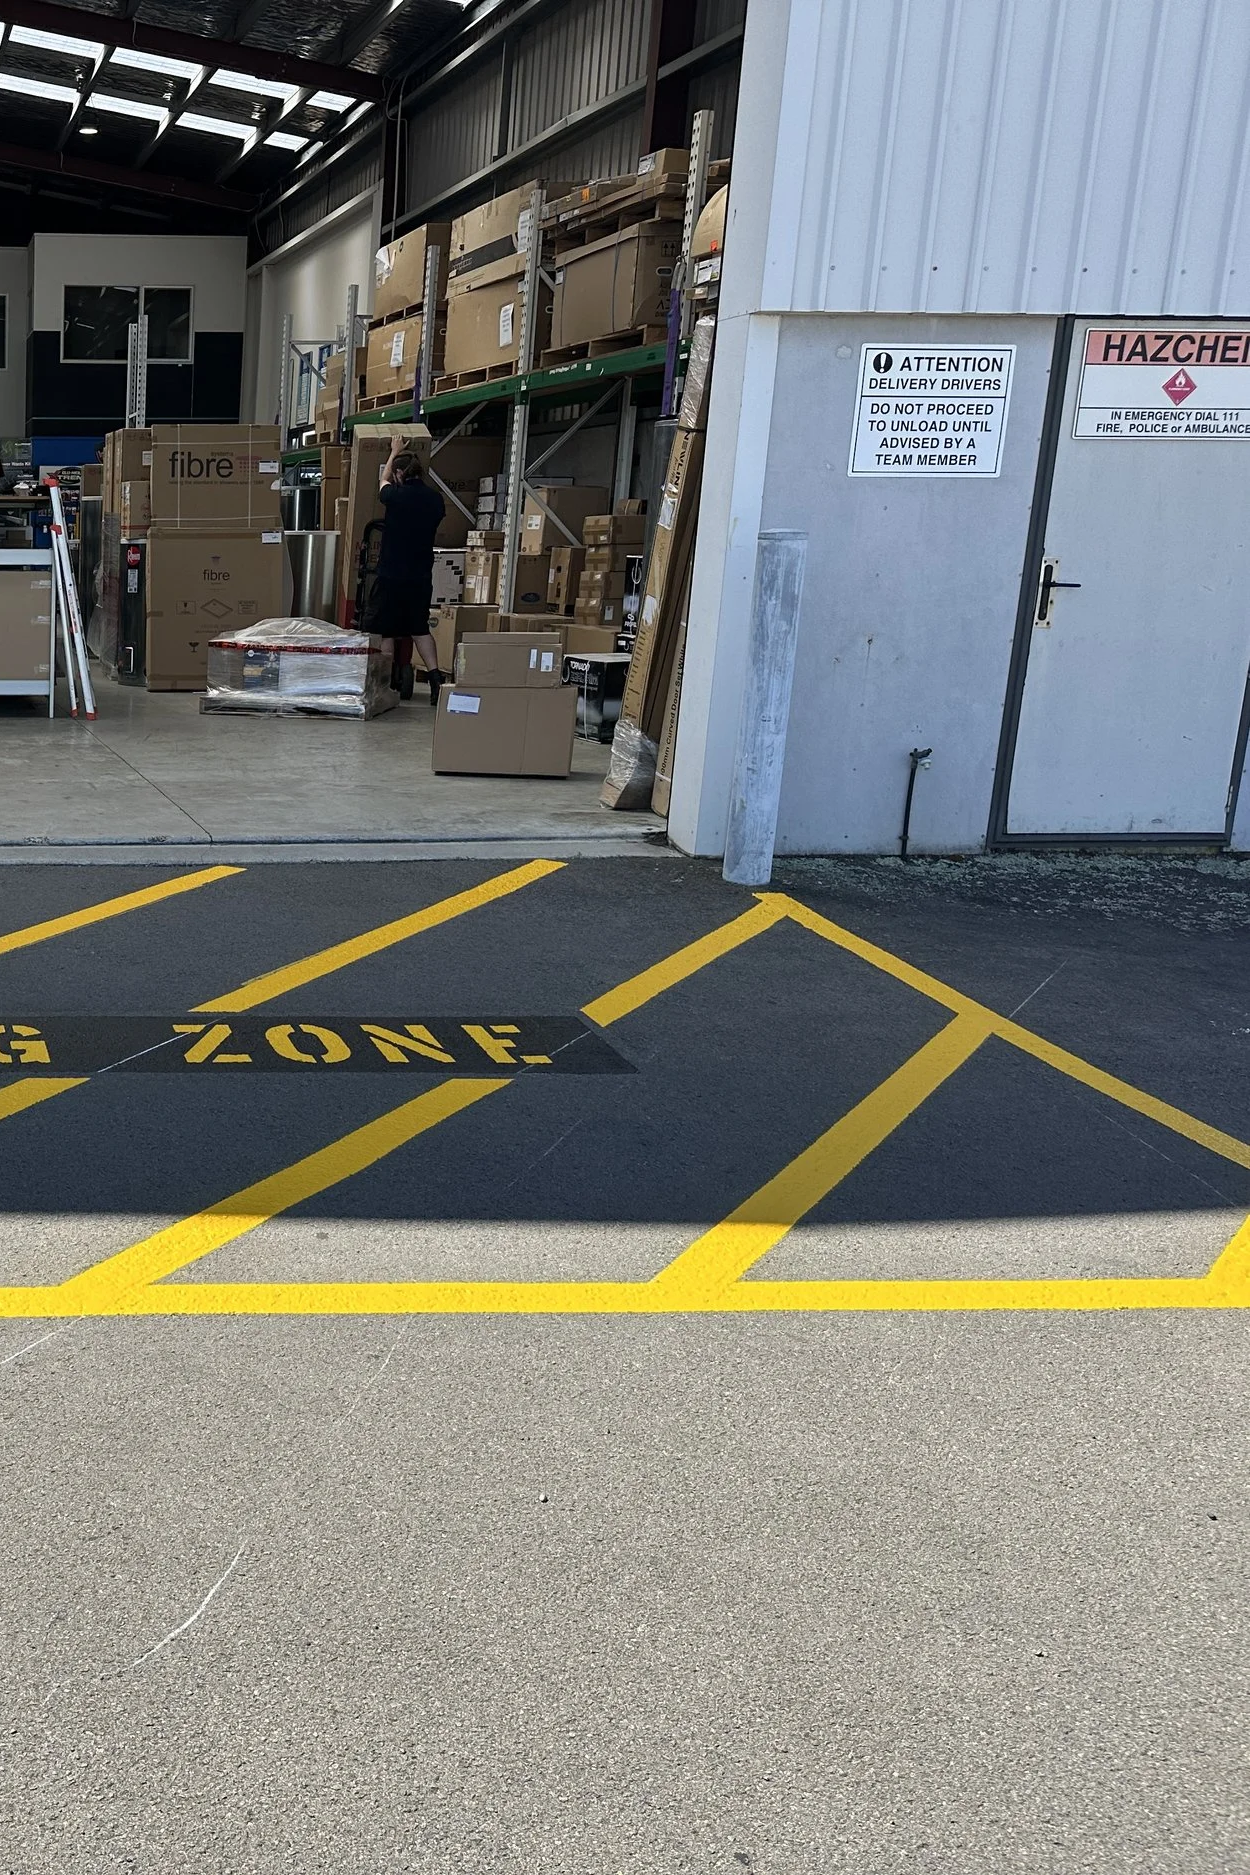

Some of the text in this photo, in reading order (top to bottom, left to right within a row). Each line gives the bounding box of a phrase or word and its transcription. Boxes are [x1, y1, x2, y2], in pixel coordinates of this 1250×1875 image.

[899, 356, 1004, 373] ATTENTION
[868, 377, 1001, 391] DELIVERY DRIVERS
[870, 403, 994, 416] DO NOT PROCEED
[1110, 411, 1240, 422] IN EMERGENCY DIAL 111
[868, 420, 992, 433] TO UNLOAD UNTIL
[1096, 423, 1250, 434] FIRE, POLICE or AMBULANCE
[879, 437, 976, 449] ADVISED BY A
[168, 451, 234, 479] fibre
[673, 430, 690, 486] NEWLIN
[875, 454, 977, 466] TEAM MEMBER
[203, 569, 230, 581] fibre
[675, 671, 683, 687] Set
[670, 689, 680, 711] Door
[666, 714, 676, 745] Curved
[171, 1022, 553, 1065] ZONE
